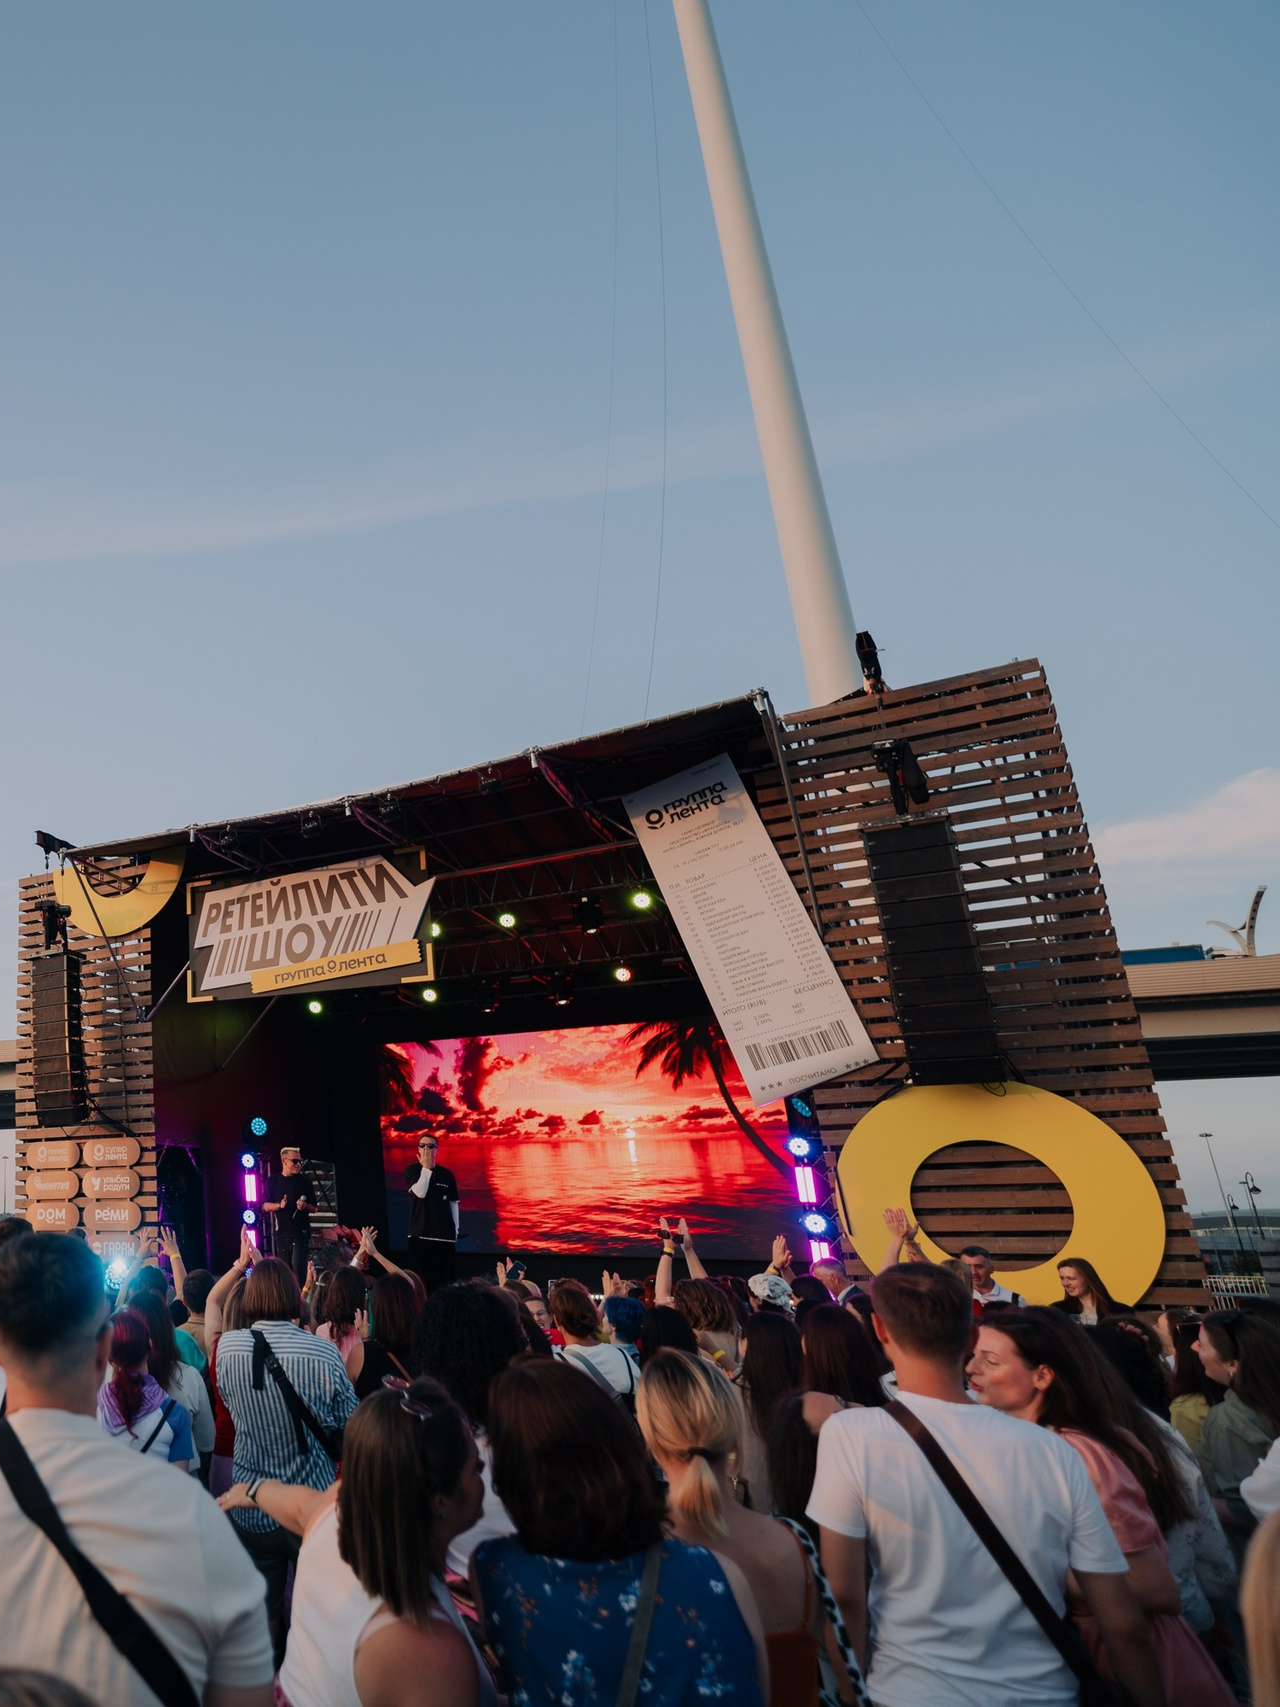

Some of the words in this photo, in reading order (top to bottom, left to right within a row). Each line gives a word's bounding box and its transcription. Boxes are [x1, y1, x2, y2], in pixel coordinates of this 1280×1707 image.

[663, 781, 727, 814] группа
[670, 794, 725, 824] лента
[685, 873, 706, 884] ТОВАР
[749, 852, 767, 862] ЦЕНА
[202, 864, 409, 938] РЕТЕЙЛИТИ
[245, 916, 343, 972] ШОУ
[274, 965, 325, 984] группа
[339, 952, 387, 972] лента
[722, 1005, 746, 1016] ИТОГО
[794, 979, 834, 995] БЕСЦЕННО
[789, 1067, 837, 1084] ПОСЧИТАНО
[105, 1145, 127, 1153] супер
[105, 1153, 127, 1161] лента
[103, 1175, 129, 1183] улыбка
[103, 1184, 130, 1192] радуги
